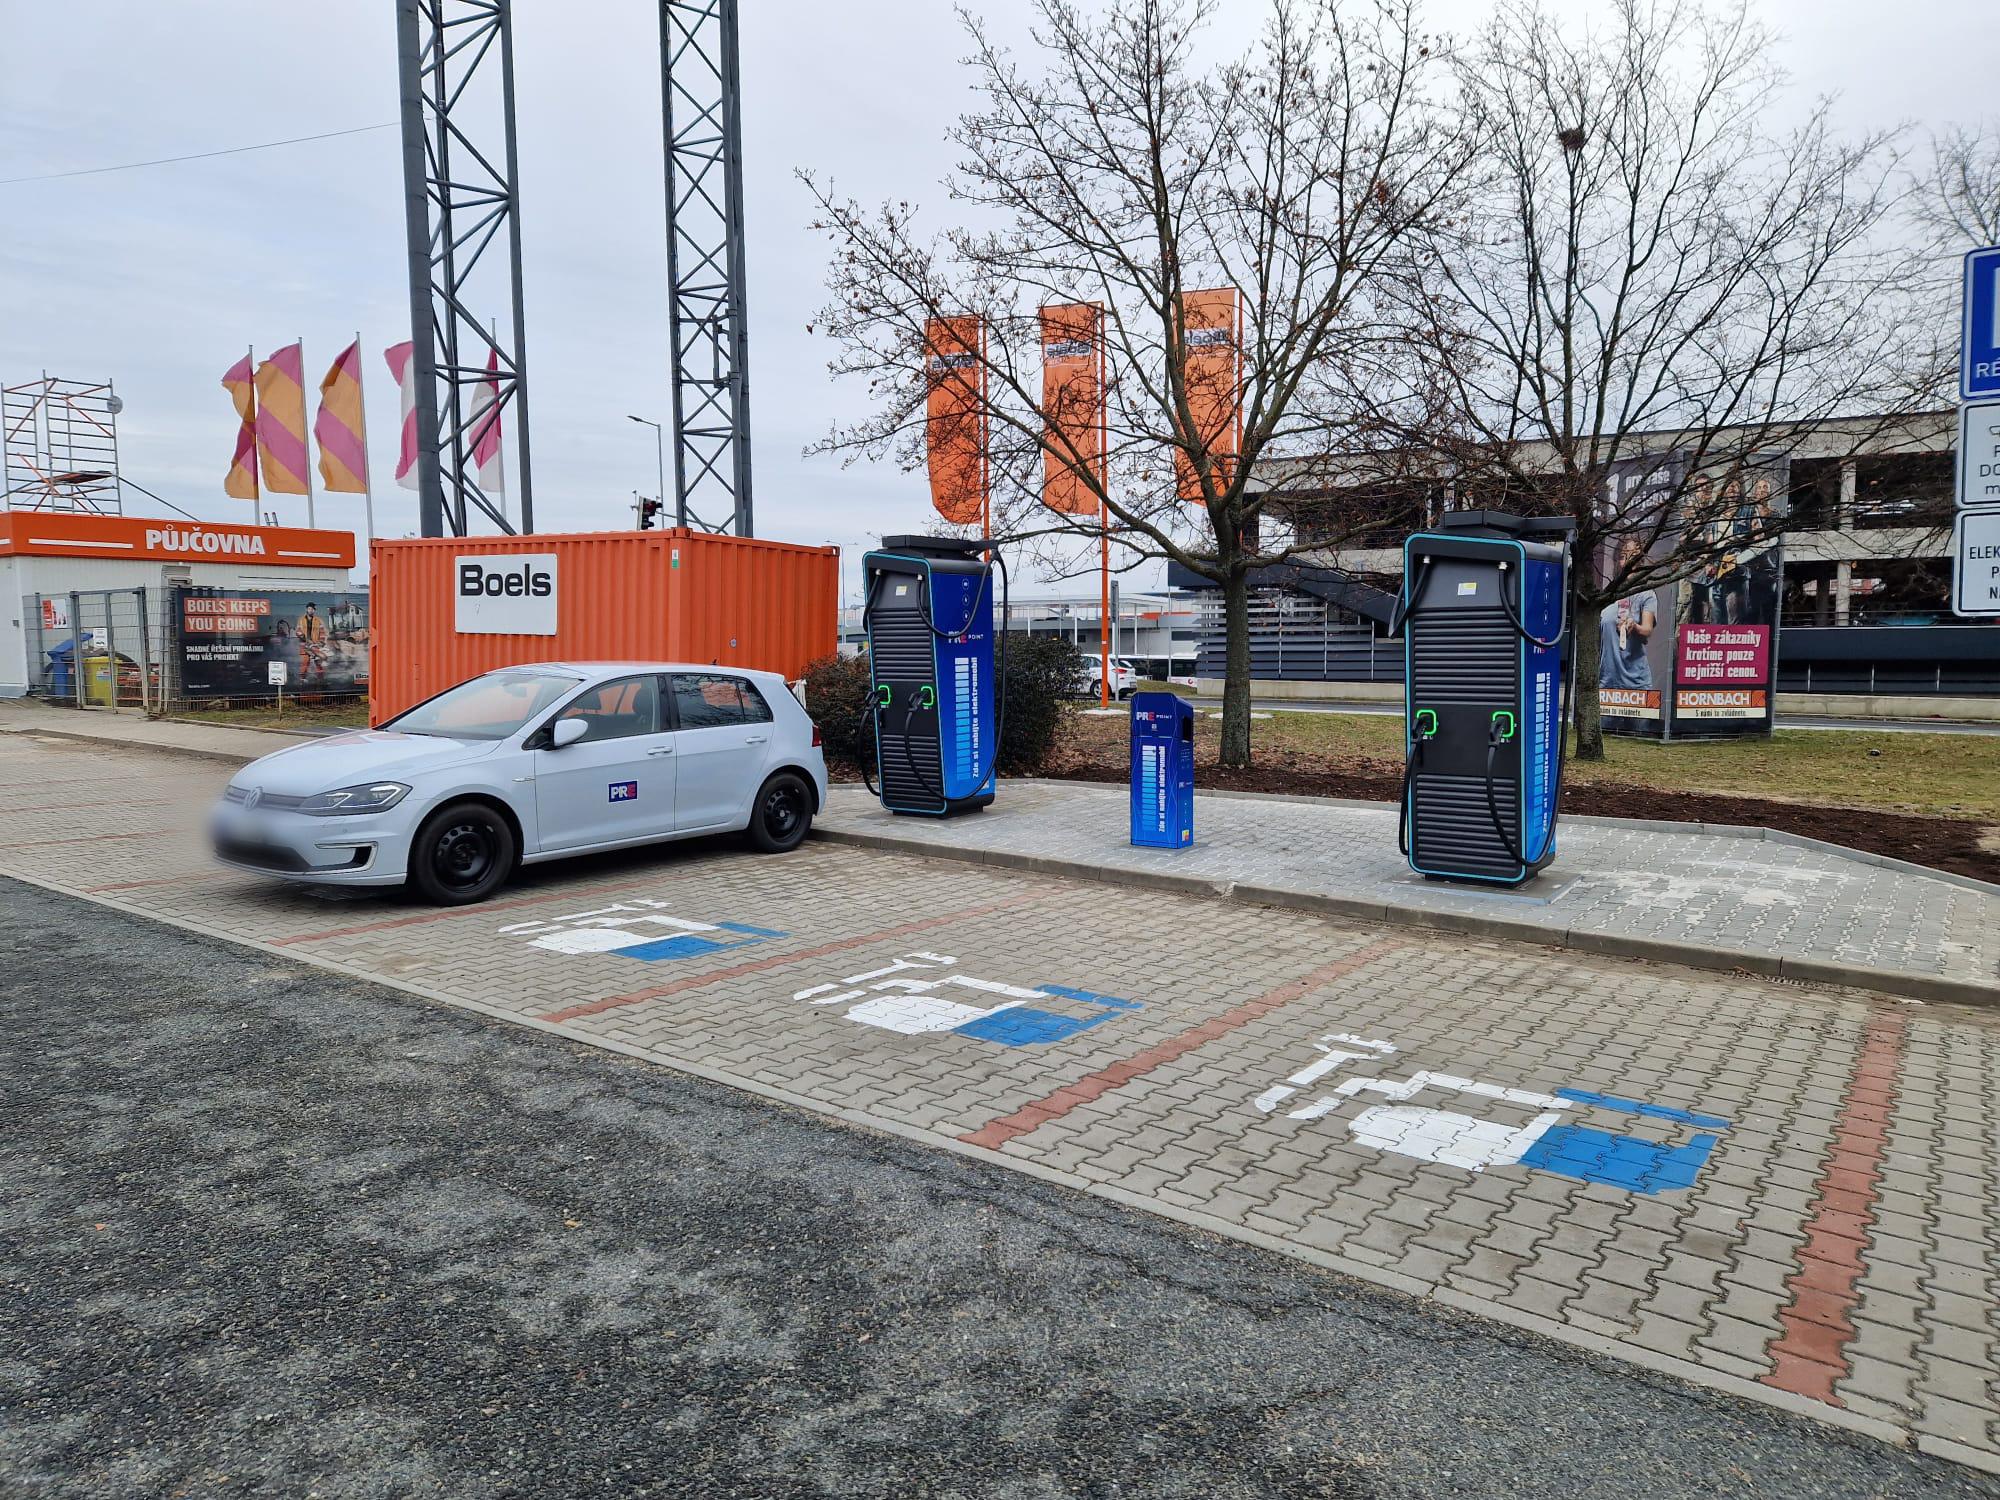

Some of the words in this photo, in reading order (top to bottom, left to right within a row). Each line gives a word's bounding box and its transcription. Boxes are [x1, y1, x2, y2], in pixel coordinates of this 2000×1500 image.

[145, 523, 266, 555] PŮJČOVNA
[460, 563, 551, 597] Boels
[1989, 586, 2000, 599] N
[187, 599, 227, 613] BOELS
[230, 600, 267, 613] KEEPS
[188, 617, 213, 631] YOU
[217, 617, 255, 631] GOING
[1687, 629, 1711, 644] Naše
[1714, 630, 1761, 647] zákazníky
[1686, 646, 1723, 661] krotíme
[1726, 650, 1754, 664] pouze
[1685, 663, 1725, 680] nejnižší
[1727, 667, 1758, 678] cenou.
[1600, 691, 1646, 705] RNBACH
[1679, 692, 1750, 706] HORNBACH
[1136, 711, 1155, 721] PRE
[611, 784, 636, 799] PRE
